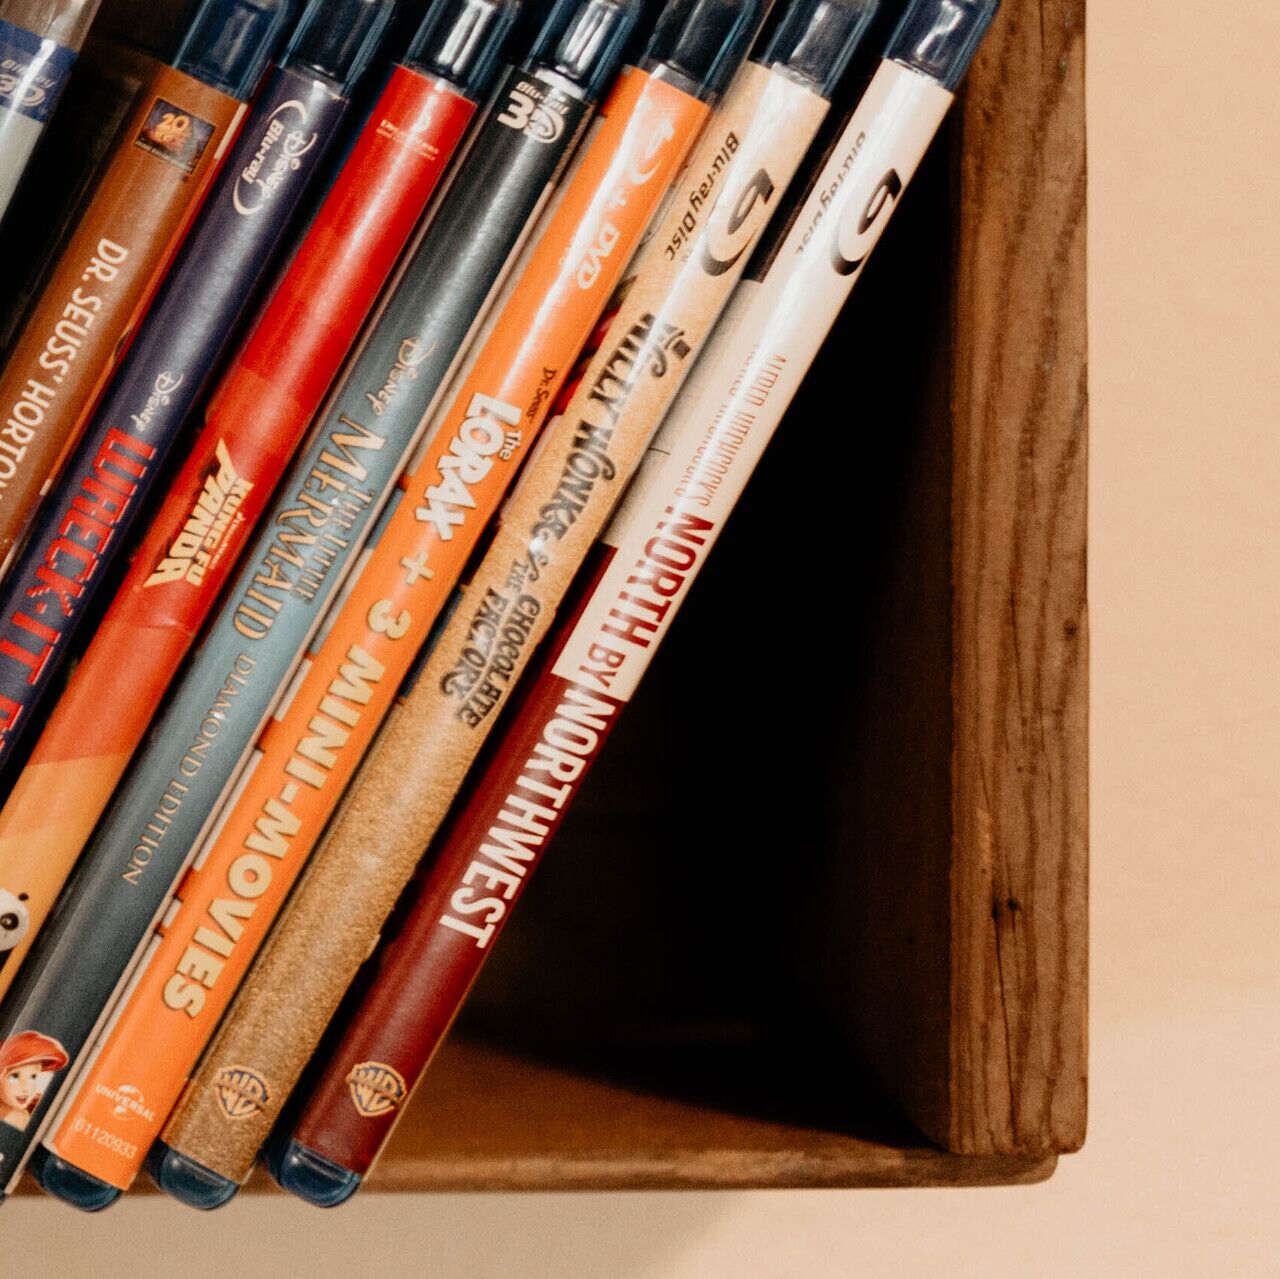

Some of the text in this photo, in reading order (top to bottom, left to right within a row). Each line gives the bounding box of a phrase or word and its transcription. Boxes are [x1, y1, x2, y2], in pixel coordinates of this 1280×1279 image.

[241, 118, 283, 183] Blu-ray
[496, 89, 566, 144] 3D
[663, 129, 740, 262] Blu-ray Disc
[81, 236, 130, 283] DR.
[39, 286, 103, 380] SEUSS'
[586, 312, 669, 426] WILLY
[143, 437, 235, 588] PANDA
[184, 544, 215, 588] FU
[201, 477, 255, 550] KUNG
[234, 415, 386, 643] MERMAID
[162, 391, 523, 1020] The LORAX + 3 MINI-MOVIES
[175, 652, 258, 778] DIAMOND
[456, 593, 541, 730] CHOCOLATE
[440, 504, 715, 950] NORTH BY NORTHWEST
[120, 778, 191, 887] EDITION
[94, 1083, 156, 1122] UNIVERSAL
